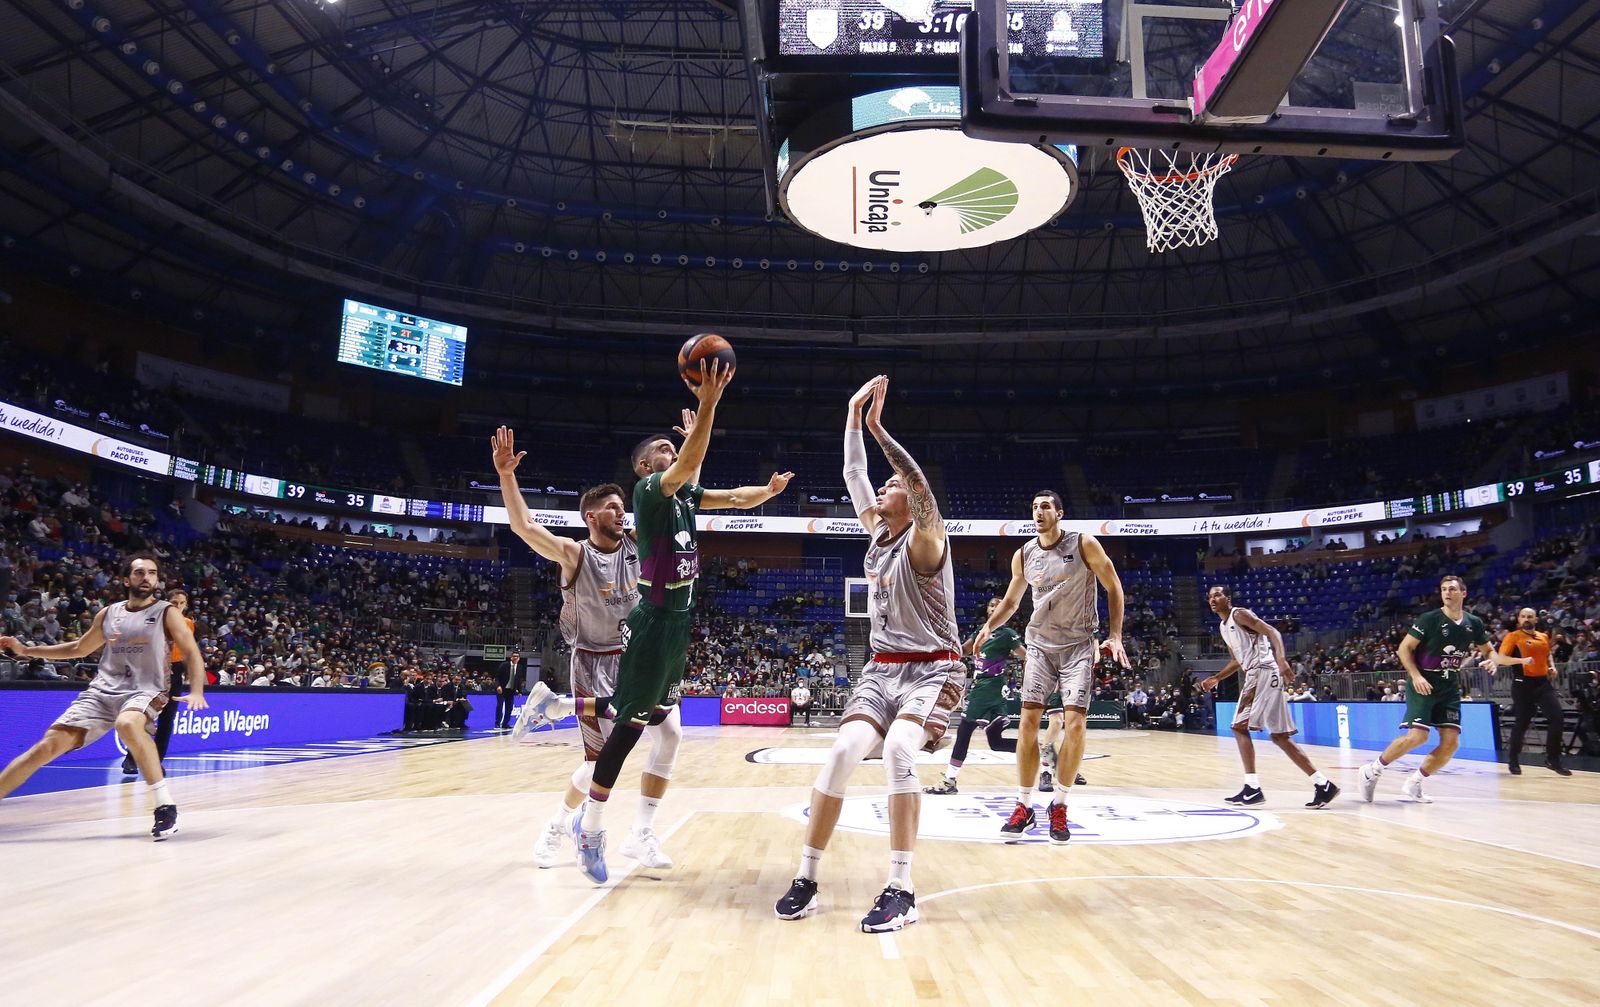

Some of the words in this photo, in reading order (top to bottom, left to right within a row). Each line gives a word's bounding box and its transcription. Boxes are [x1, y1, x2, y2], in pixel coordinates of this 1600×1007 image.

[859, 10, 885, 30] 39
[915, 42, 923, 53] 2
[859, 170, 903, 233] Unicaja
[10, 417, 56, 438] medida
[110, 451, 130, 461] PACO
[130, 455, 149, 465] PEPE
[1564, 468, 1582, 485] 35
[287, 484, 306, 498] 39
[1506, 481, 1524, 497] 39
[346, 493, 365, 507] 35
[1200, 520, 1208, 531] A
[1211, 519, 1221, 531] tu
[1224, 517, 1264, 531] medida
[1322, 514, 1343, 524] PACO
[1343, 511, 1363, 521] PEPE
[745, 522, 764, 530] PEPE
[826, 525, 846, 533] PACO
[846, 526, 864, 534] PEPE
[724, 700, 788, 714] endesa
[223, 710, 269, 736] Wagen
